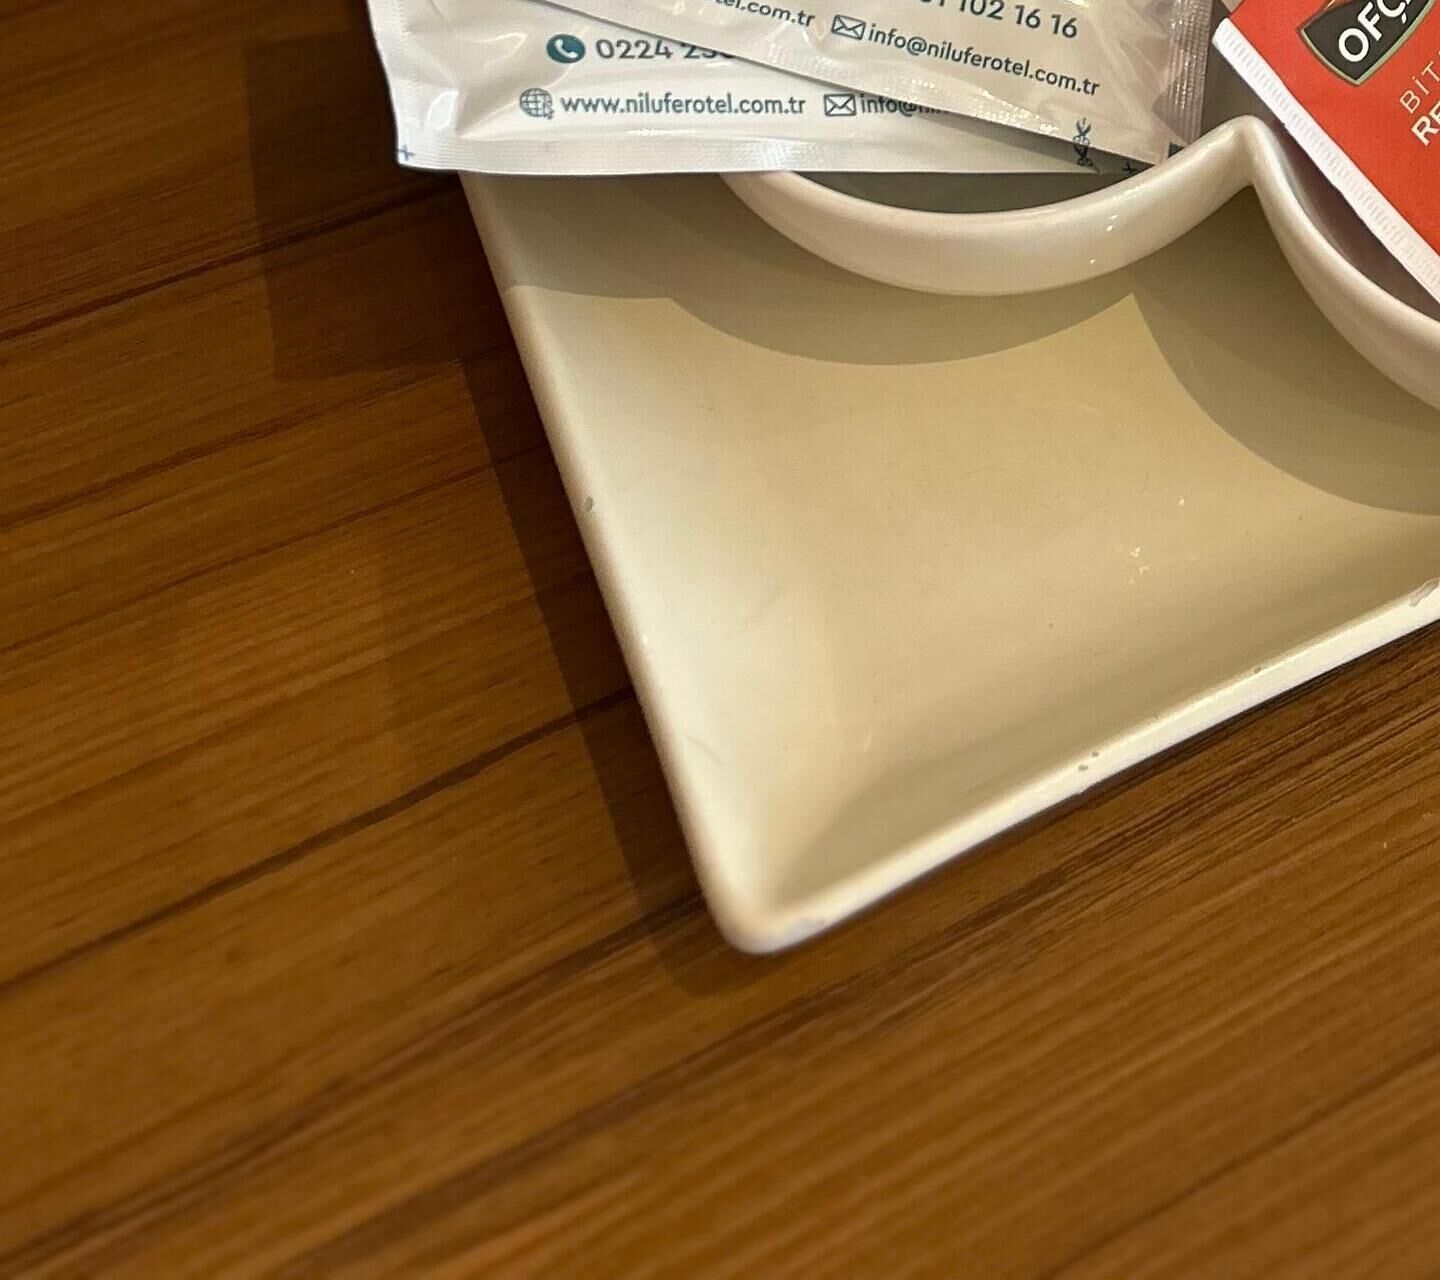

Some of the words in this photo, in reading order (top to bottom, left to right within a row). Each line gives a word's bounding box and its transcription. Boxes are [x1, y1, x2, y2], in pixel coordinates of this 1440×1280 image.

[1014, 4, 1042, 30] 16
[1050, 13, 1079, 39] 16
[595, 39, 673, 60] 0224
[868, 23, 1101, 97] info@niluferotel.com.tr
[561, 93, 807, 116] www.niluferotel.com.tr
